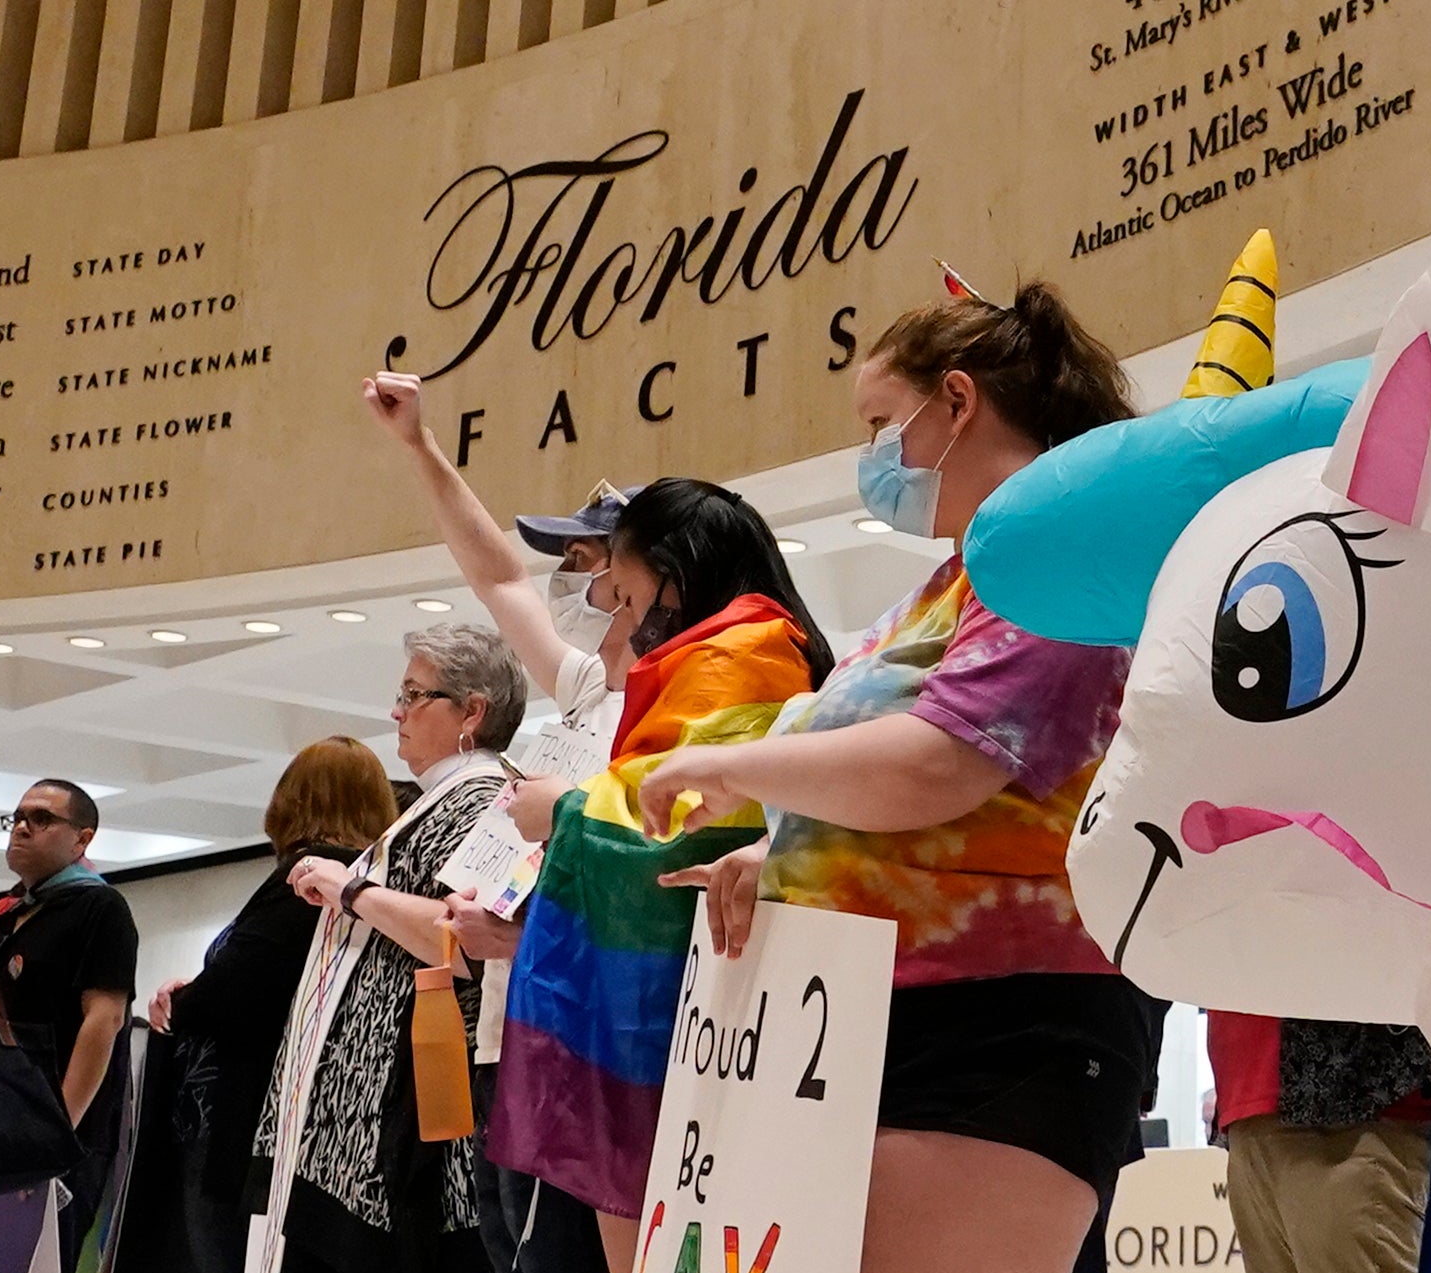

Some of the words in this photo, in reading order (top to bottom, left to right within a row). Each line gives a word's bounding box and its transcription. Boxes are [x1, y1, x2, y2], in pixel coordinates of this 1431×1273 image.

[1089, 44, 1116, 72] St.
[1125, 3, 1192, 58] Mary's
[1095, 85, 1187, 143] WIDTH
[1204, 44, 1268, 95] EAST
[1285, 30, 1300, 53] &
[1120, 141, 1175, 197] 361
[1187, 106, 1268, 170] Miles
[1277, 56, 1364, 120] Wide
[1070, 208, 1154, 259] Atlantic
[1161, 179, 1227, 221] Ocean
[1235, 167, 1256, 190] to
[1262, 121, 1347, 178] Perdido
[1354, 87, 1415, 135] River
[72, 253, 144, 278] STATE
[157, 242, 206, 265] DAY
[385, 88, 918, 381] Florida
[65, 310, 136, 335] STATE
[149, 294, 237, 323] MOTTO
[57, 369, 129, 394] STATE
[143, 346, 273, 380] NICKNAME
[457, 306, 857, 467] FACTS
[50, 427, 122, 452] STATE
[135, 411, 233, 441] FLOWER
[42, 480, 169, 512] COUNTIES
[34, 546, 107, 571] STATE
[122, 540, 164, 561] PIE
[672, 942, 767, 1082] Proud
[795, 975, 829, 1101] 2
[676, 1120, 714, 1204] Be
